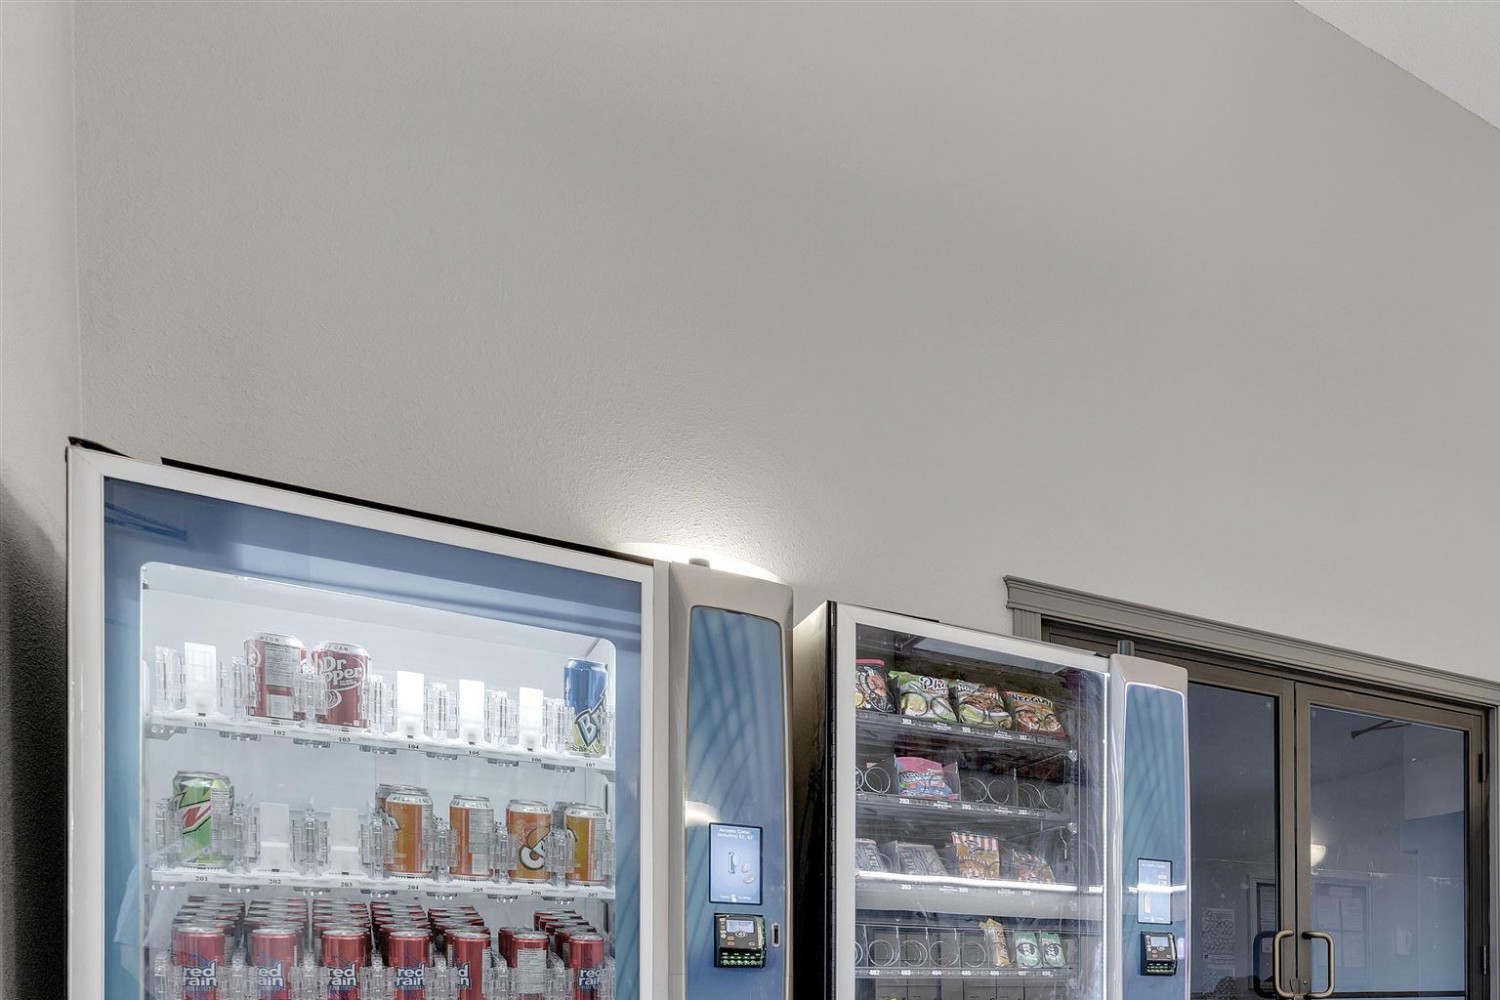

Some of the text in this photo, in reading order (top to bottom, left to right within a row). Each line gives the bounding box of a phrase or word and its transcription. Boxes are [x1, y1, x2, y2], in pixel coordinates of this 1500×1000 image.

[322, 655, 347, 674] Dr
[183, 963, 216, 977] red
[258, 963, 282, 977] ed
[396, 963, 425, 978] red
[184, 976, 217, 987] rain
[258, 976, 284, 987] ain
